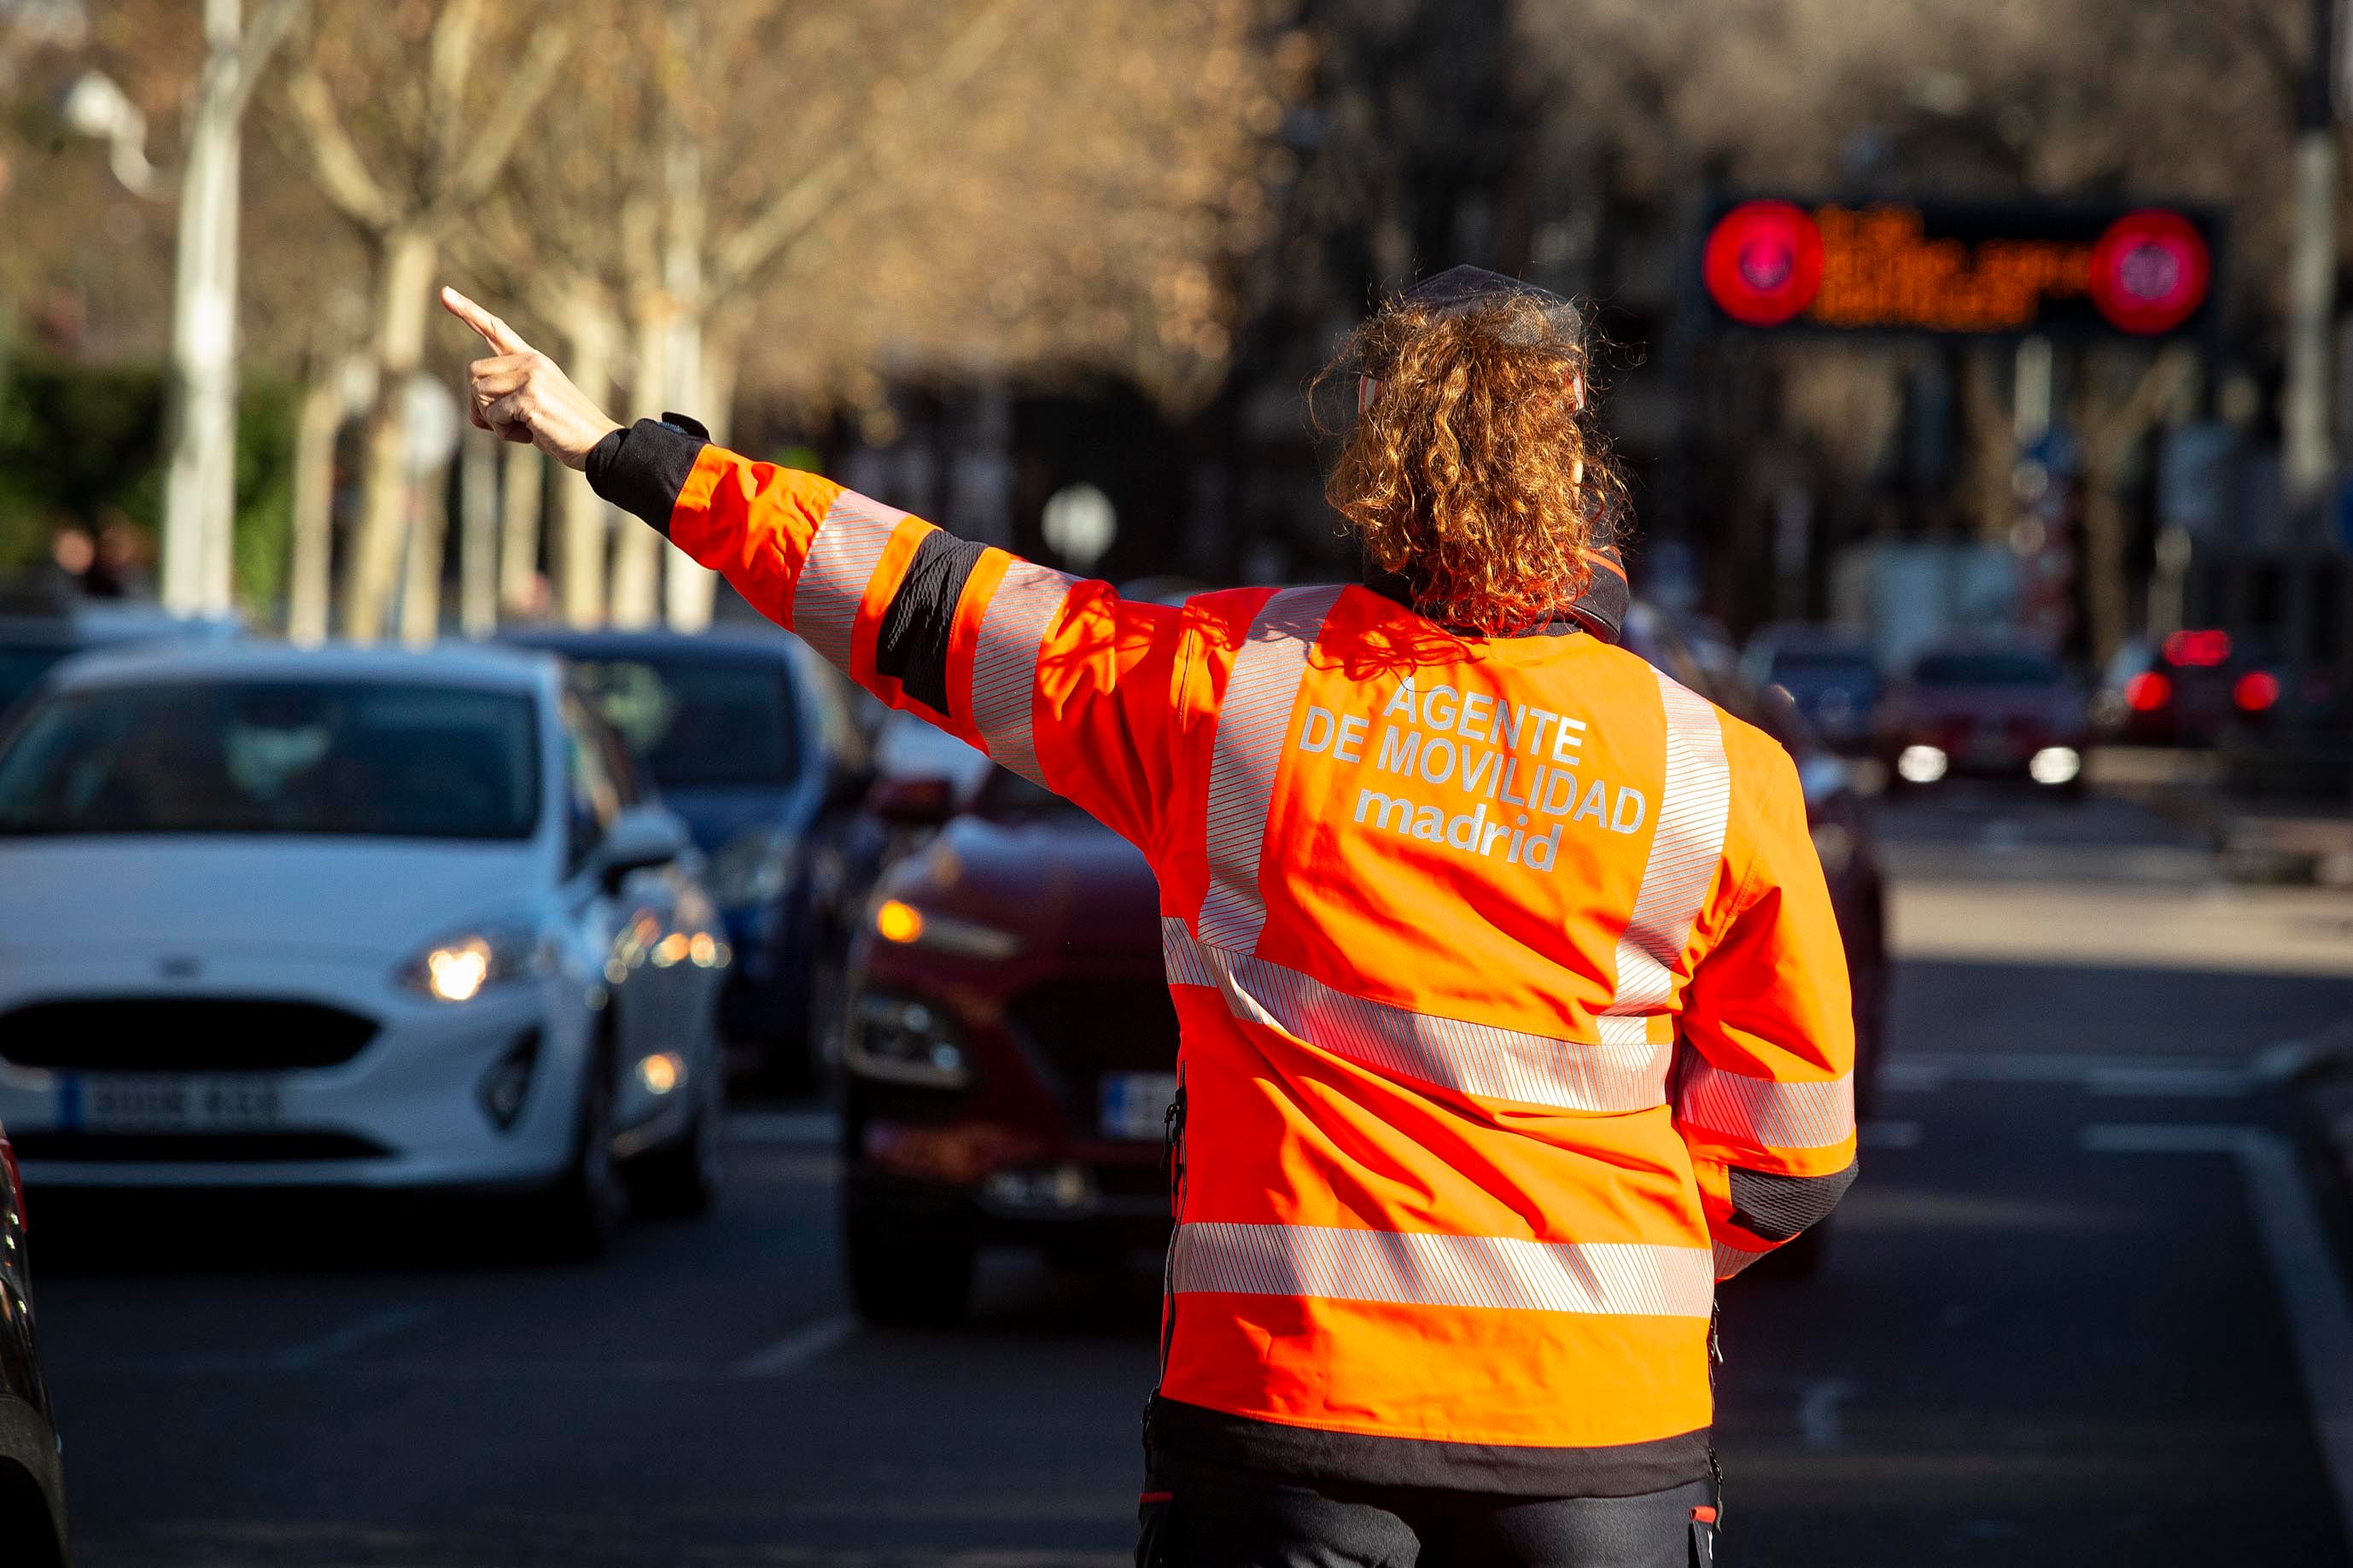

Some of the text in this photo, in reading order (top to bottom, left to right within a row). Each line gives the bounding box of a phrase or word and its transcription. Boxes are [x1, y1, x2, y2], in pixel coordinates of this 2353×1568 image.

[1383, 677, 1587, 766] AGENTE
[1299, 706, 1647, 836] DE MOVILIDAD
[1353, 789, 1564, 873] madrid
